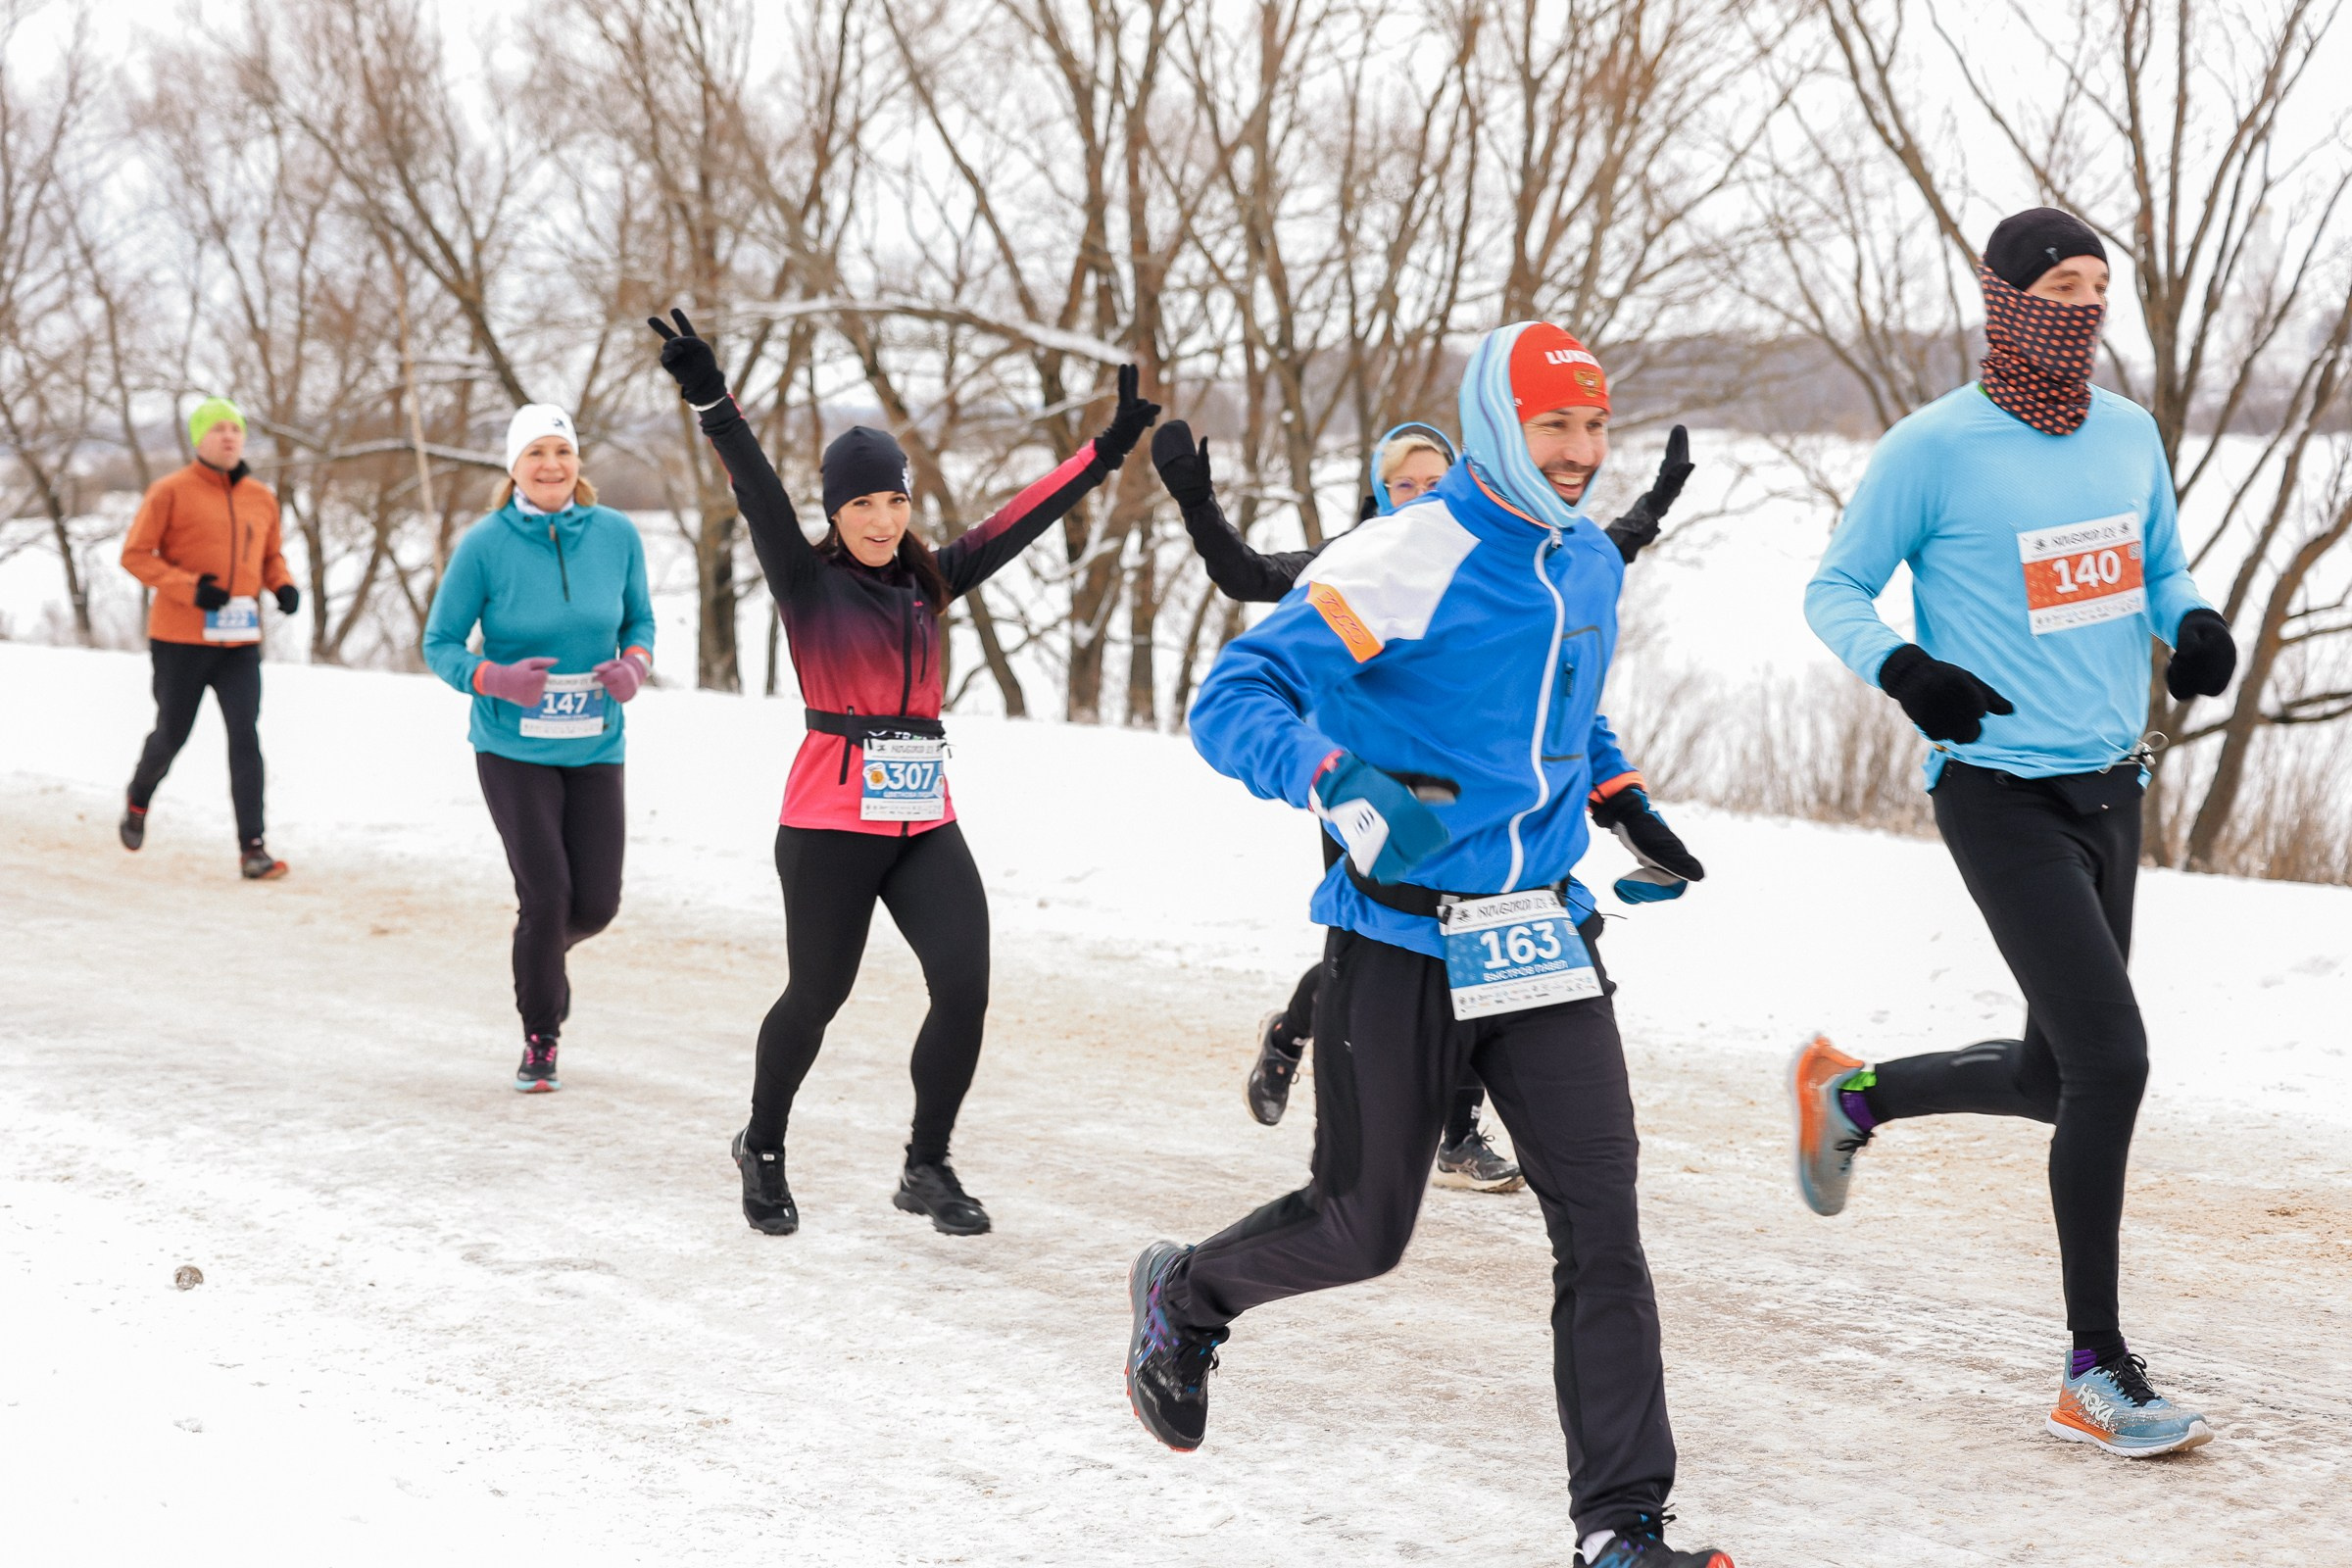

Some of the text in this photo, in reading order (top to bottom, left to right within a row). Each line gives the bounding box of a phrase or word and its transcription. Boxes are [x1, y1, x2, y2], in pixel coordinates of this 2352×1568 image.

[2052, 549, 2122, 594] 140
[542, 692, 588, 714] 147
[887, 762, 934, 791] 307
[1480, 921, 1562, 969] 163
[2076, 1383, 2117, 1427] HOKA
